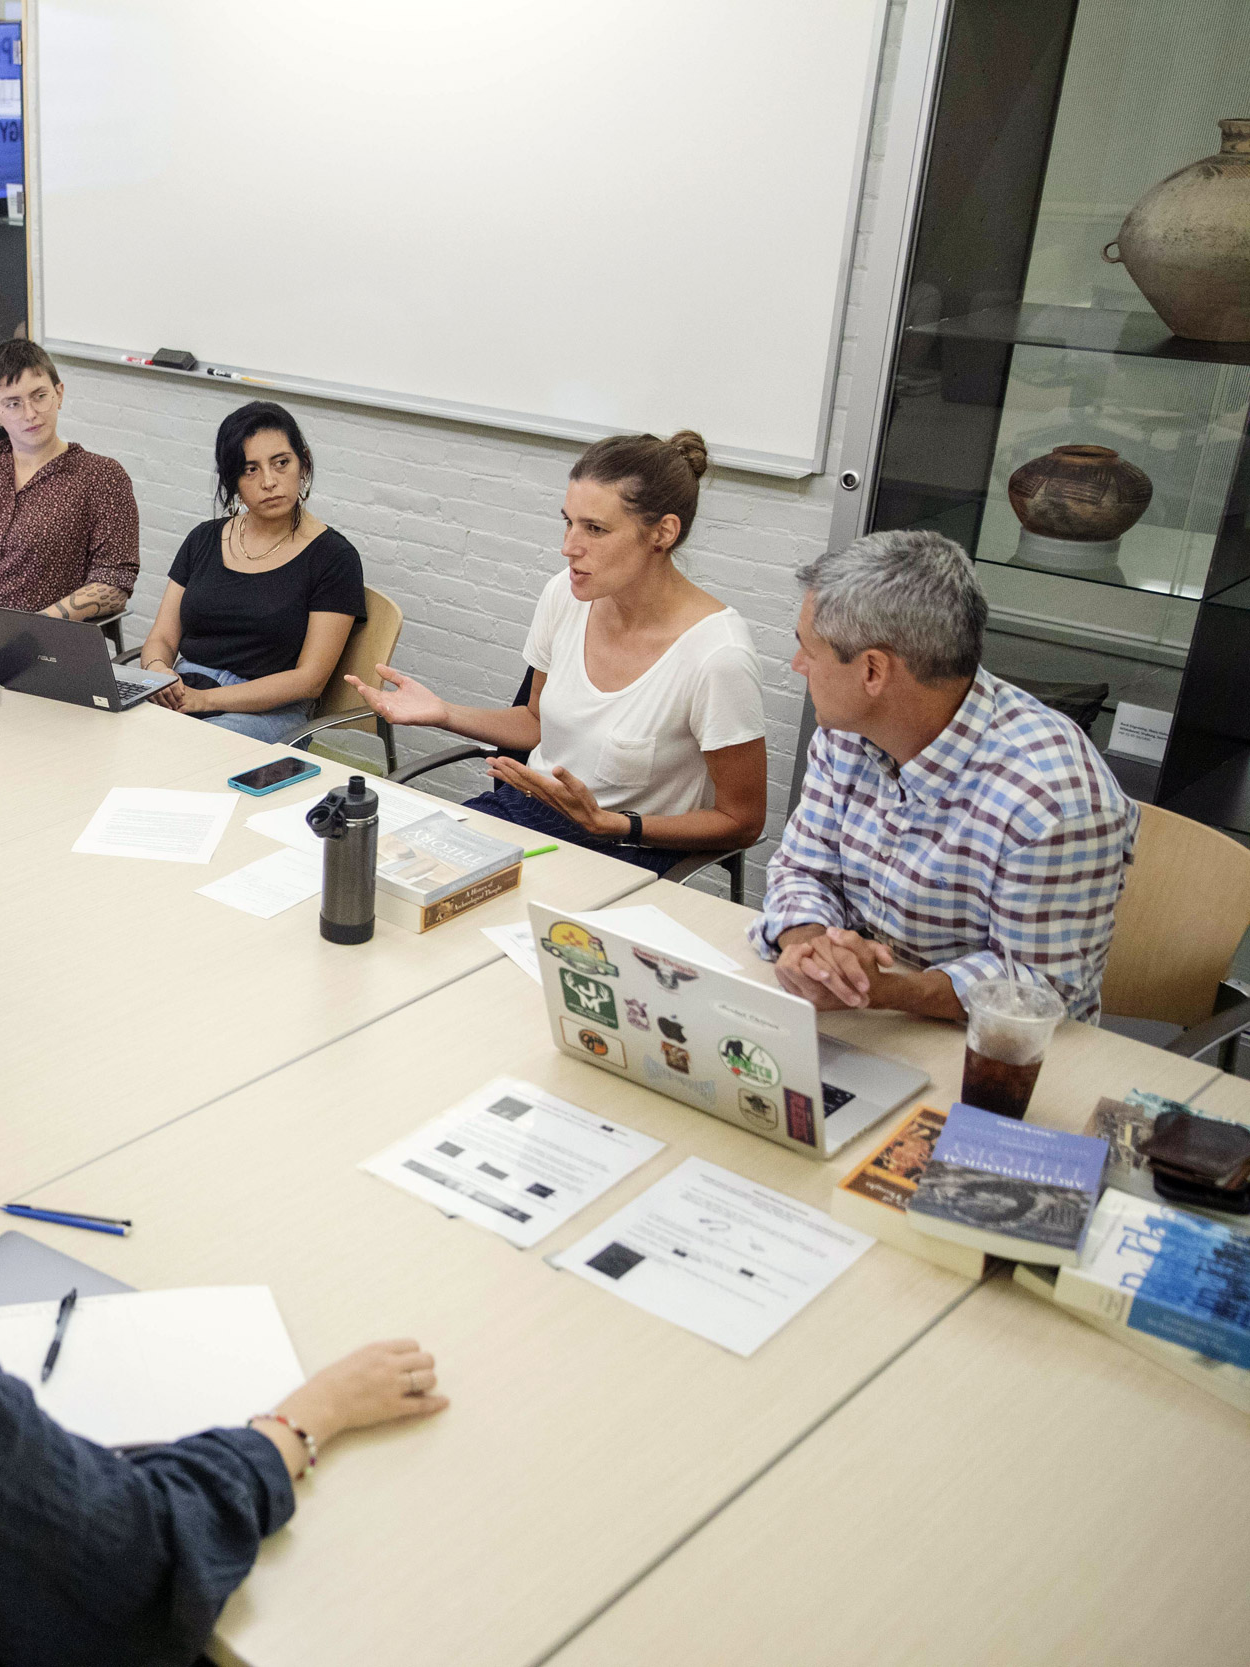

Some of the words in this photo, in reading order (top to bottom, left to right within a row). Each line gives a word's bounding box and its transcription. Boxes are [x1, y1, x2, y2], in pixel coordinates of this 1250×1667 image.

[37, 654, 57, 663] ASUS
[407, 829, 484, 865] THEORY
[578, 982, 596, 998] J
[580, 996, 601, 1013] M
